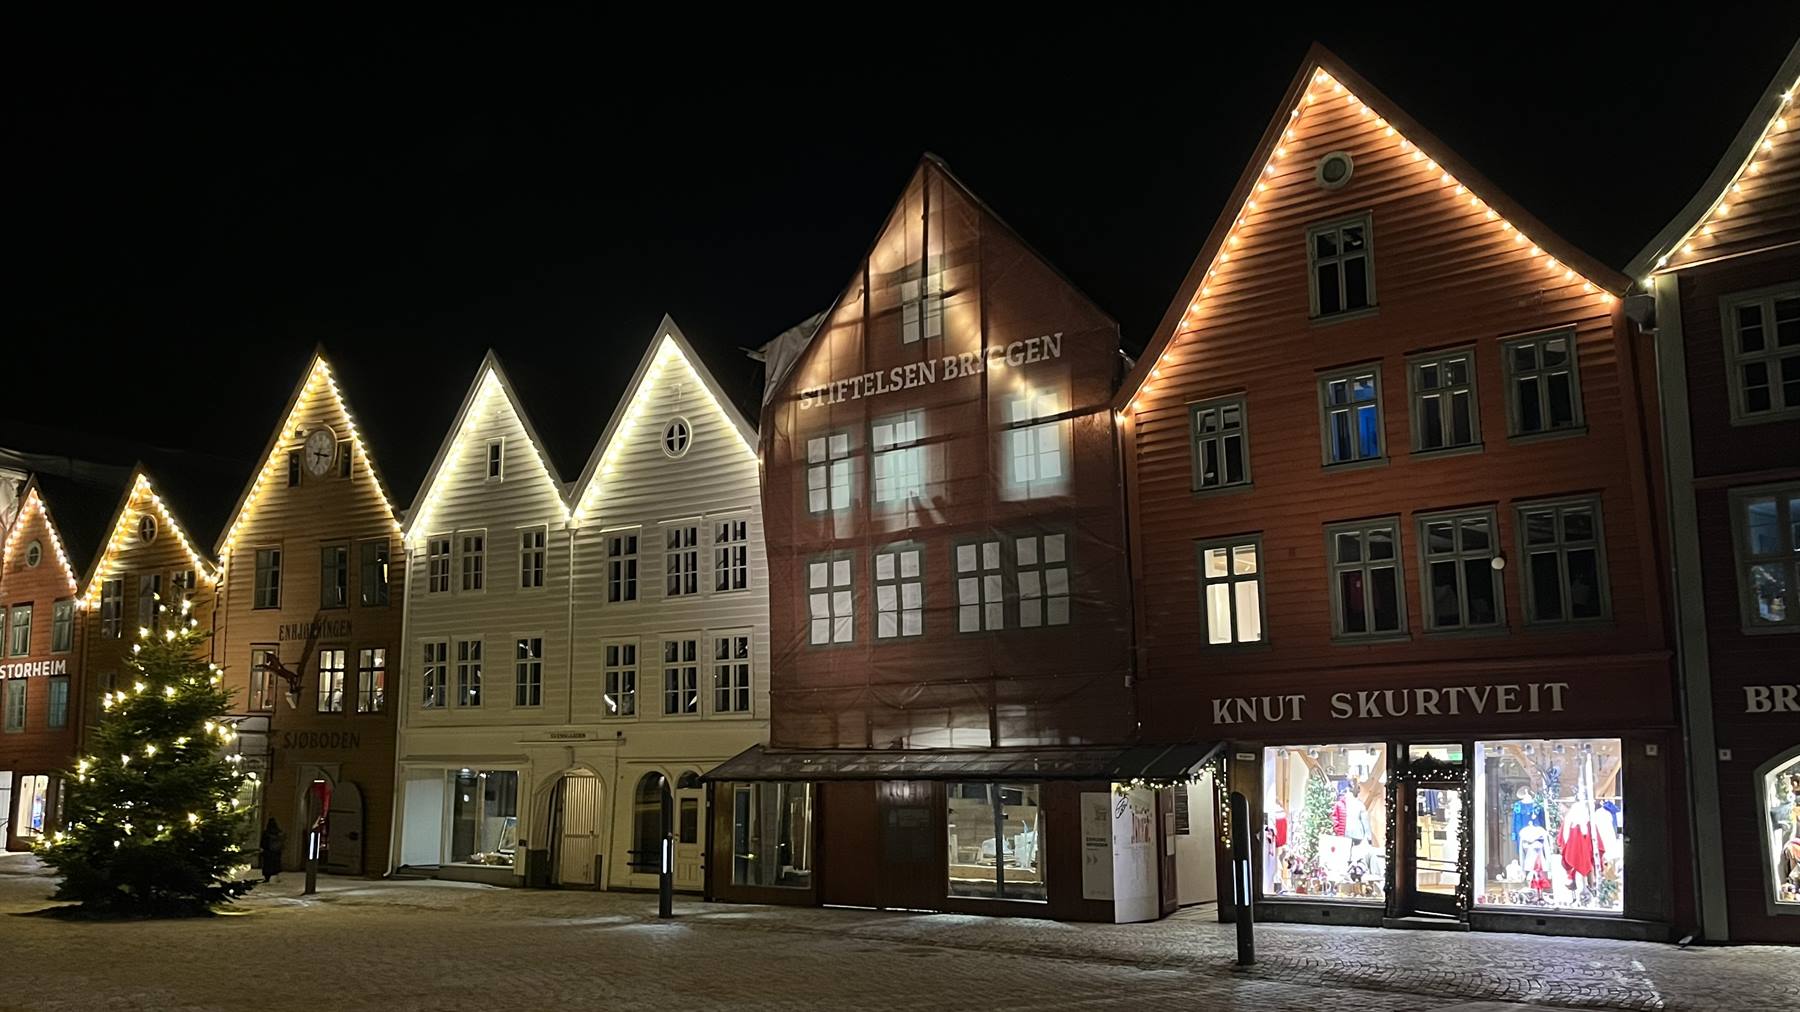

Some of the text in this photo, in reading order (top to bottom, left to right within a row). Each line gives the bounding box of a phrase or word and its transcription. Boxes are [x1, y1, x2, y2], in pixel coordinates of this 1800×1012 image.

[800, 332, 1064, 410] STIFTELSEN BRYGGEN
[0, 659, 67, 680] STORHEIM
[1211, 682, 1570, 725] KNUT SKURTVEIT
[1742, 684, 1800, 713] BR
